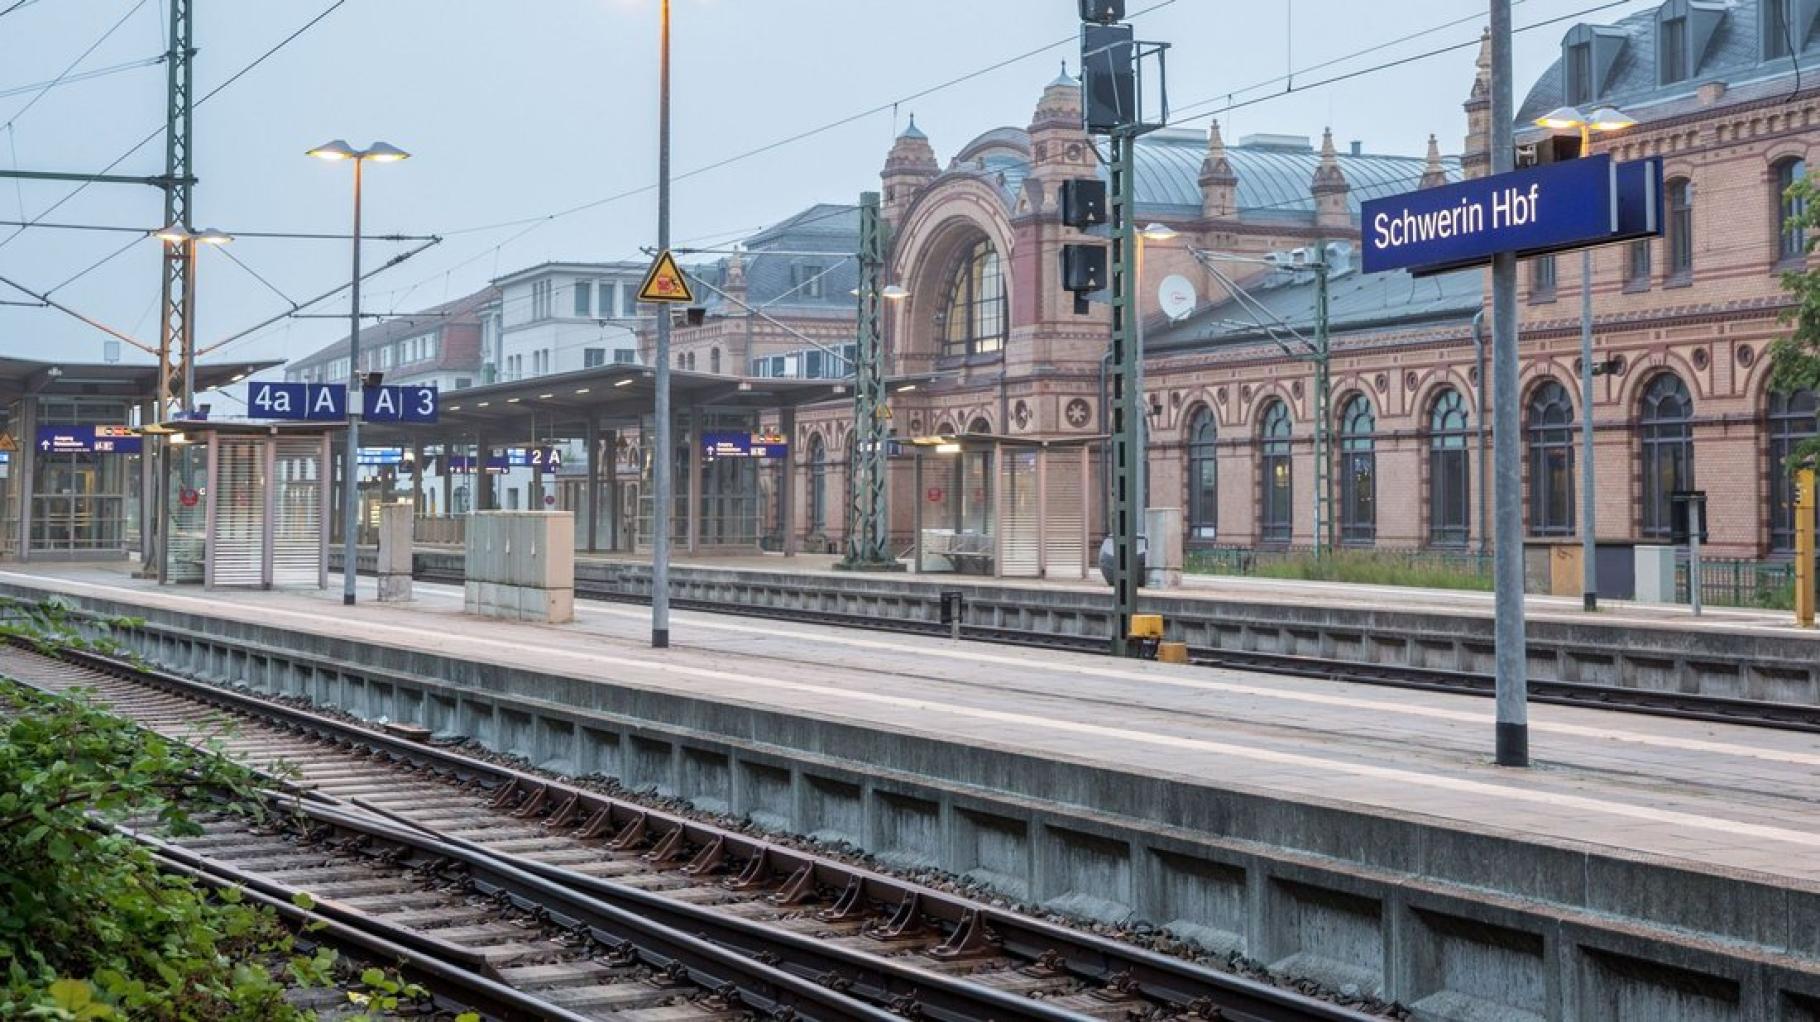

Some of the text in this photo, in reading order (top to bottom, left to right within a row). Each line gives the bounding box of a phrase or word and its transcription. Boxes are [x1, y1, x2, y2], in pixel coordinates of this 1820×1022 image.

[1374, 183, 1539, 249] Schwerin Hbf
[254, 385, 335, 412] 4a A
[375, 388, 434, 415] A 3
[531, 449, 542, 465] 2
[548, 449, 560, 465] A
